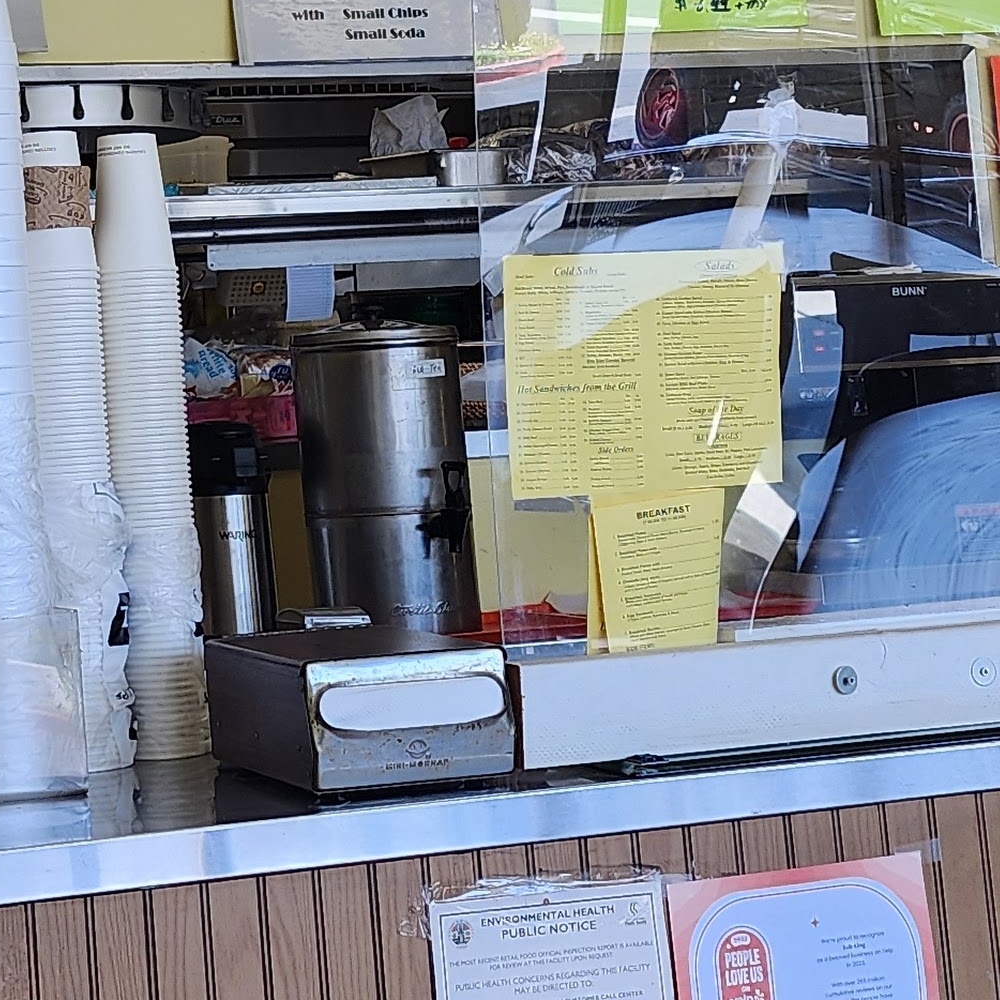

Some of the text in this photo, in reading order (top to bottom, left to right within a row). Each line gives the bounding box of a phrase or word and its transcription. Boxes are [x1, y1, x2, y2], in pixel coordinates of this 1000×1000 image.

[292, 7, 428, 20] with Small Chips
[345, 28, 425, 39] Small Soda
[554, 266, 598, 276] Cold Subs
[704, 261, 736, 271] Salads
[891, 287, 925, 297] BUNN
[582, 383, 602, 393] from
[604, 382, 617, 391] the
[619, 381, 637, 391] Grill
[636, 505, 691, 520] BREAKFAST
[481, 904, 615, 928] ENVIRONMENTAL HEALTH
[501, 920, 597, 940] PUBLIC NOTICE
[724, 948, 761, 968] PEOPLE
[725, 966, 764, 987] LOVE US
